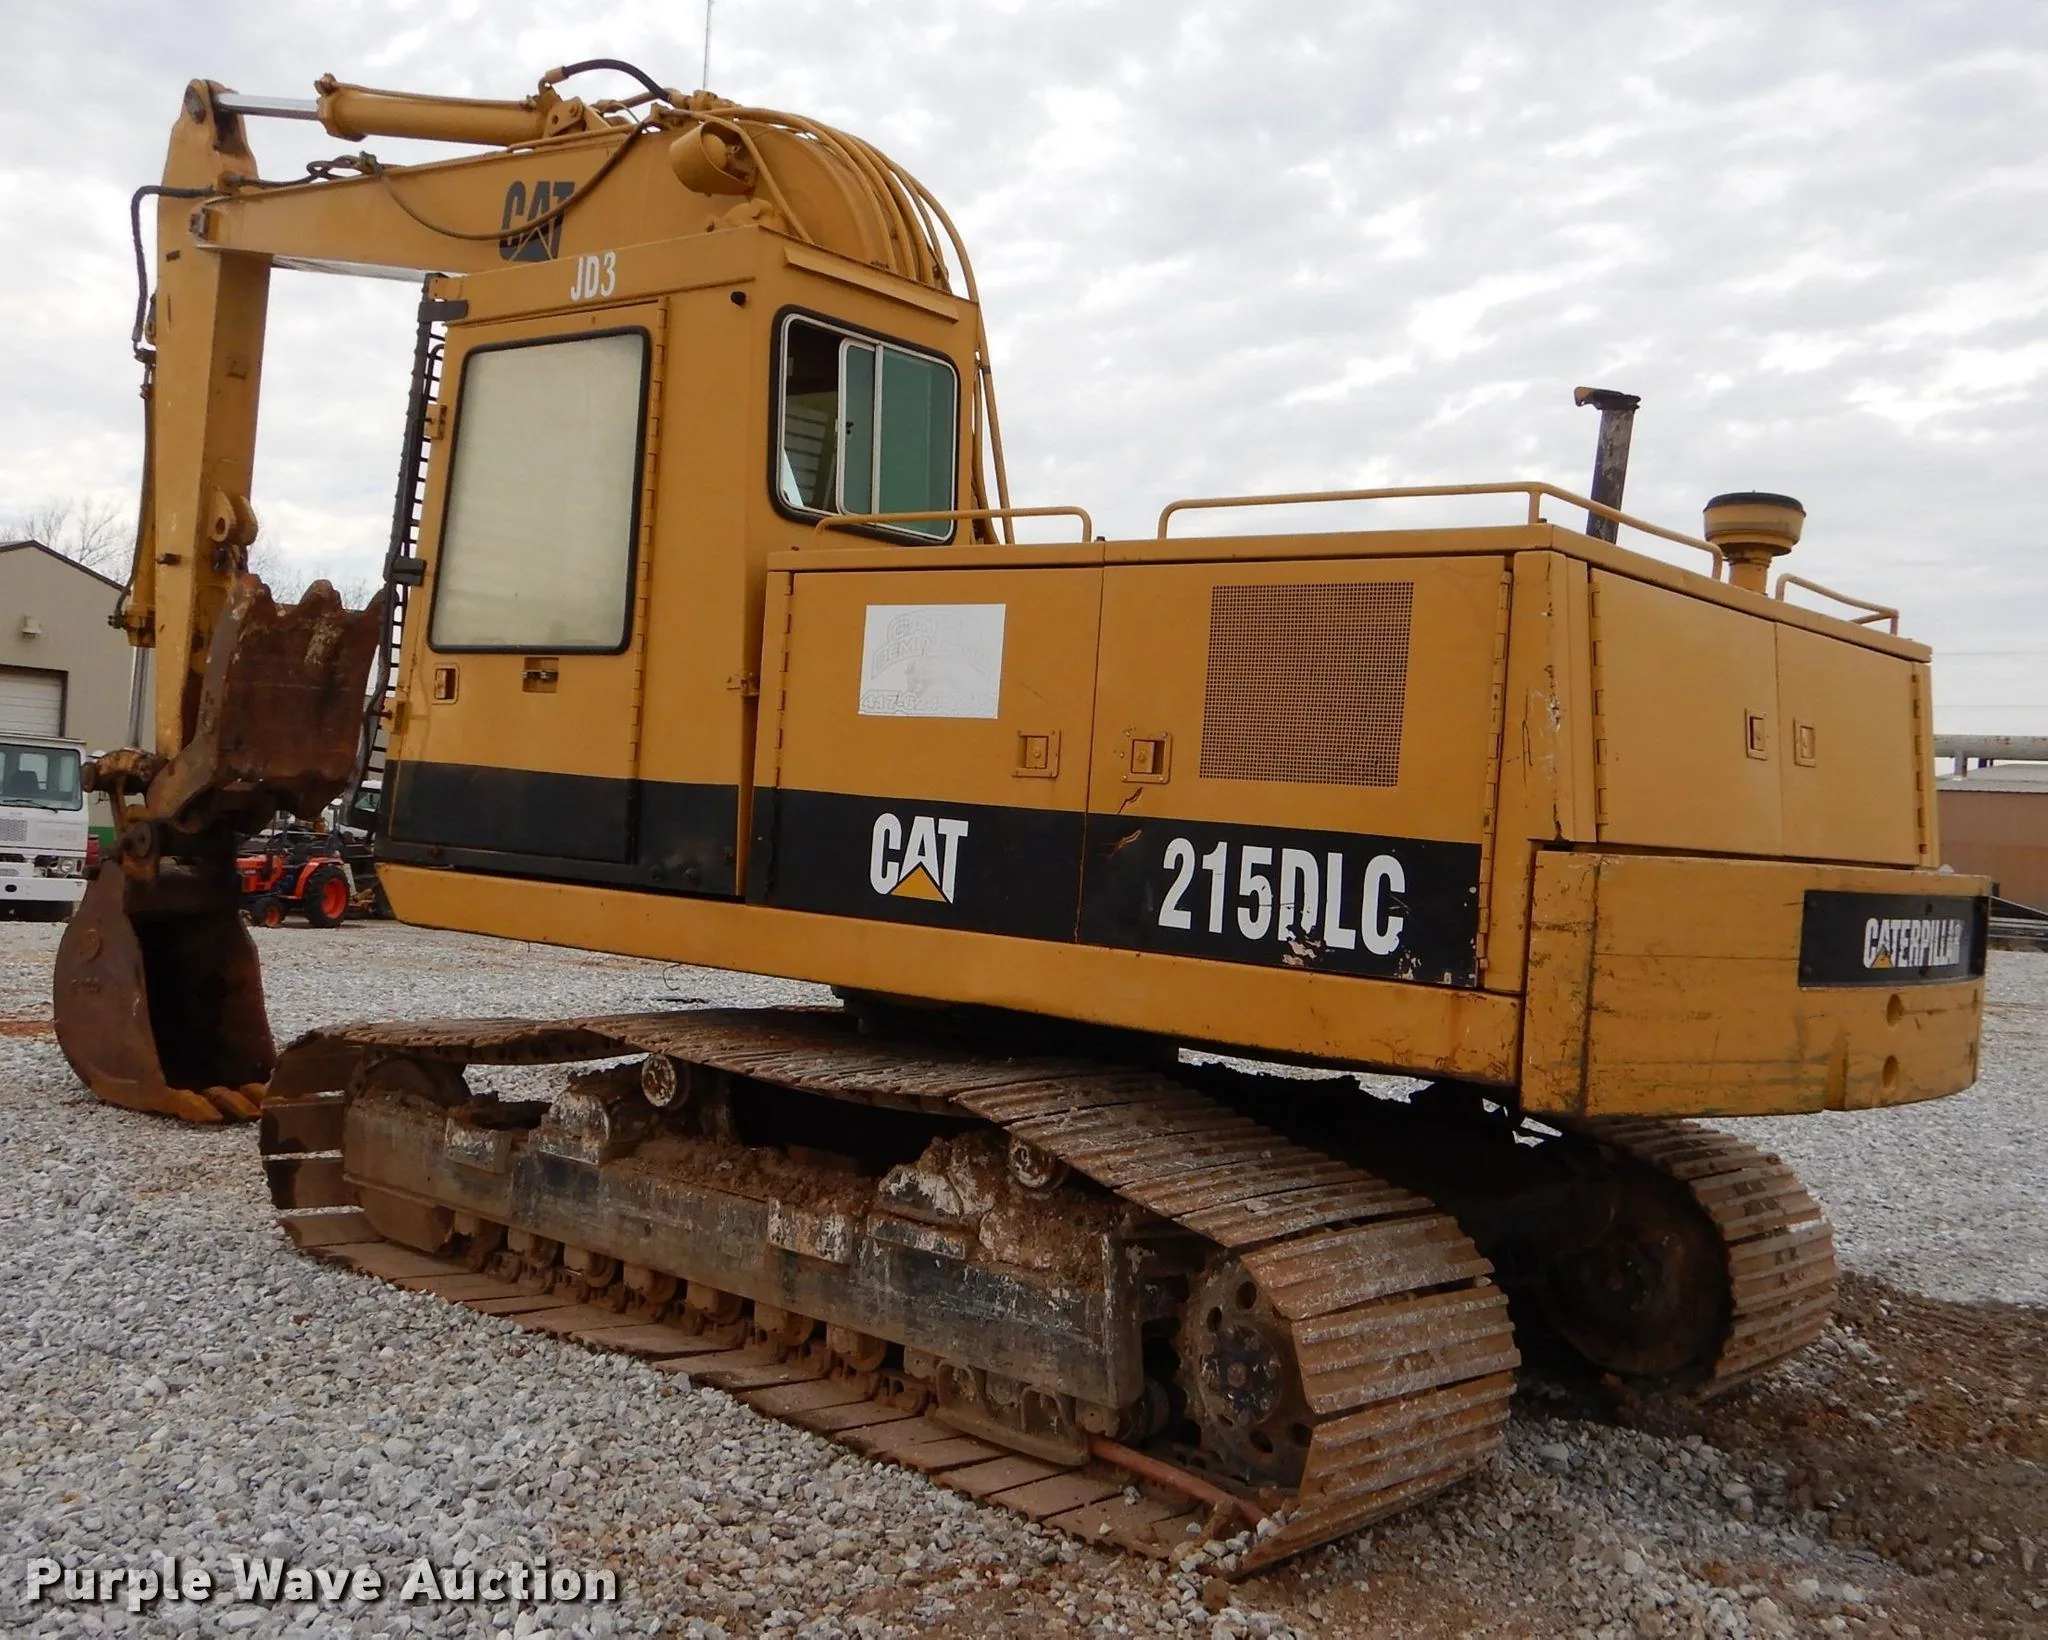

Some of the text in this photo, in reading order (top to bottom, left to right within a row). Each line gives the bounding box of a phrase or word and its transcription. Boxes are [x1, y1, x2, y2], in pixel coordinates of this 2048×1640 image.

[499, 180, 575, 262] CAT
[570, 251, 616, 301] JD3
[869, 813, 969, 904] CAT
[1158, 838, 1406, 955] 215DLC
